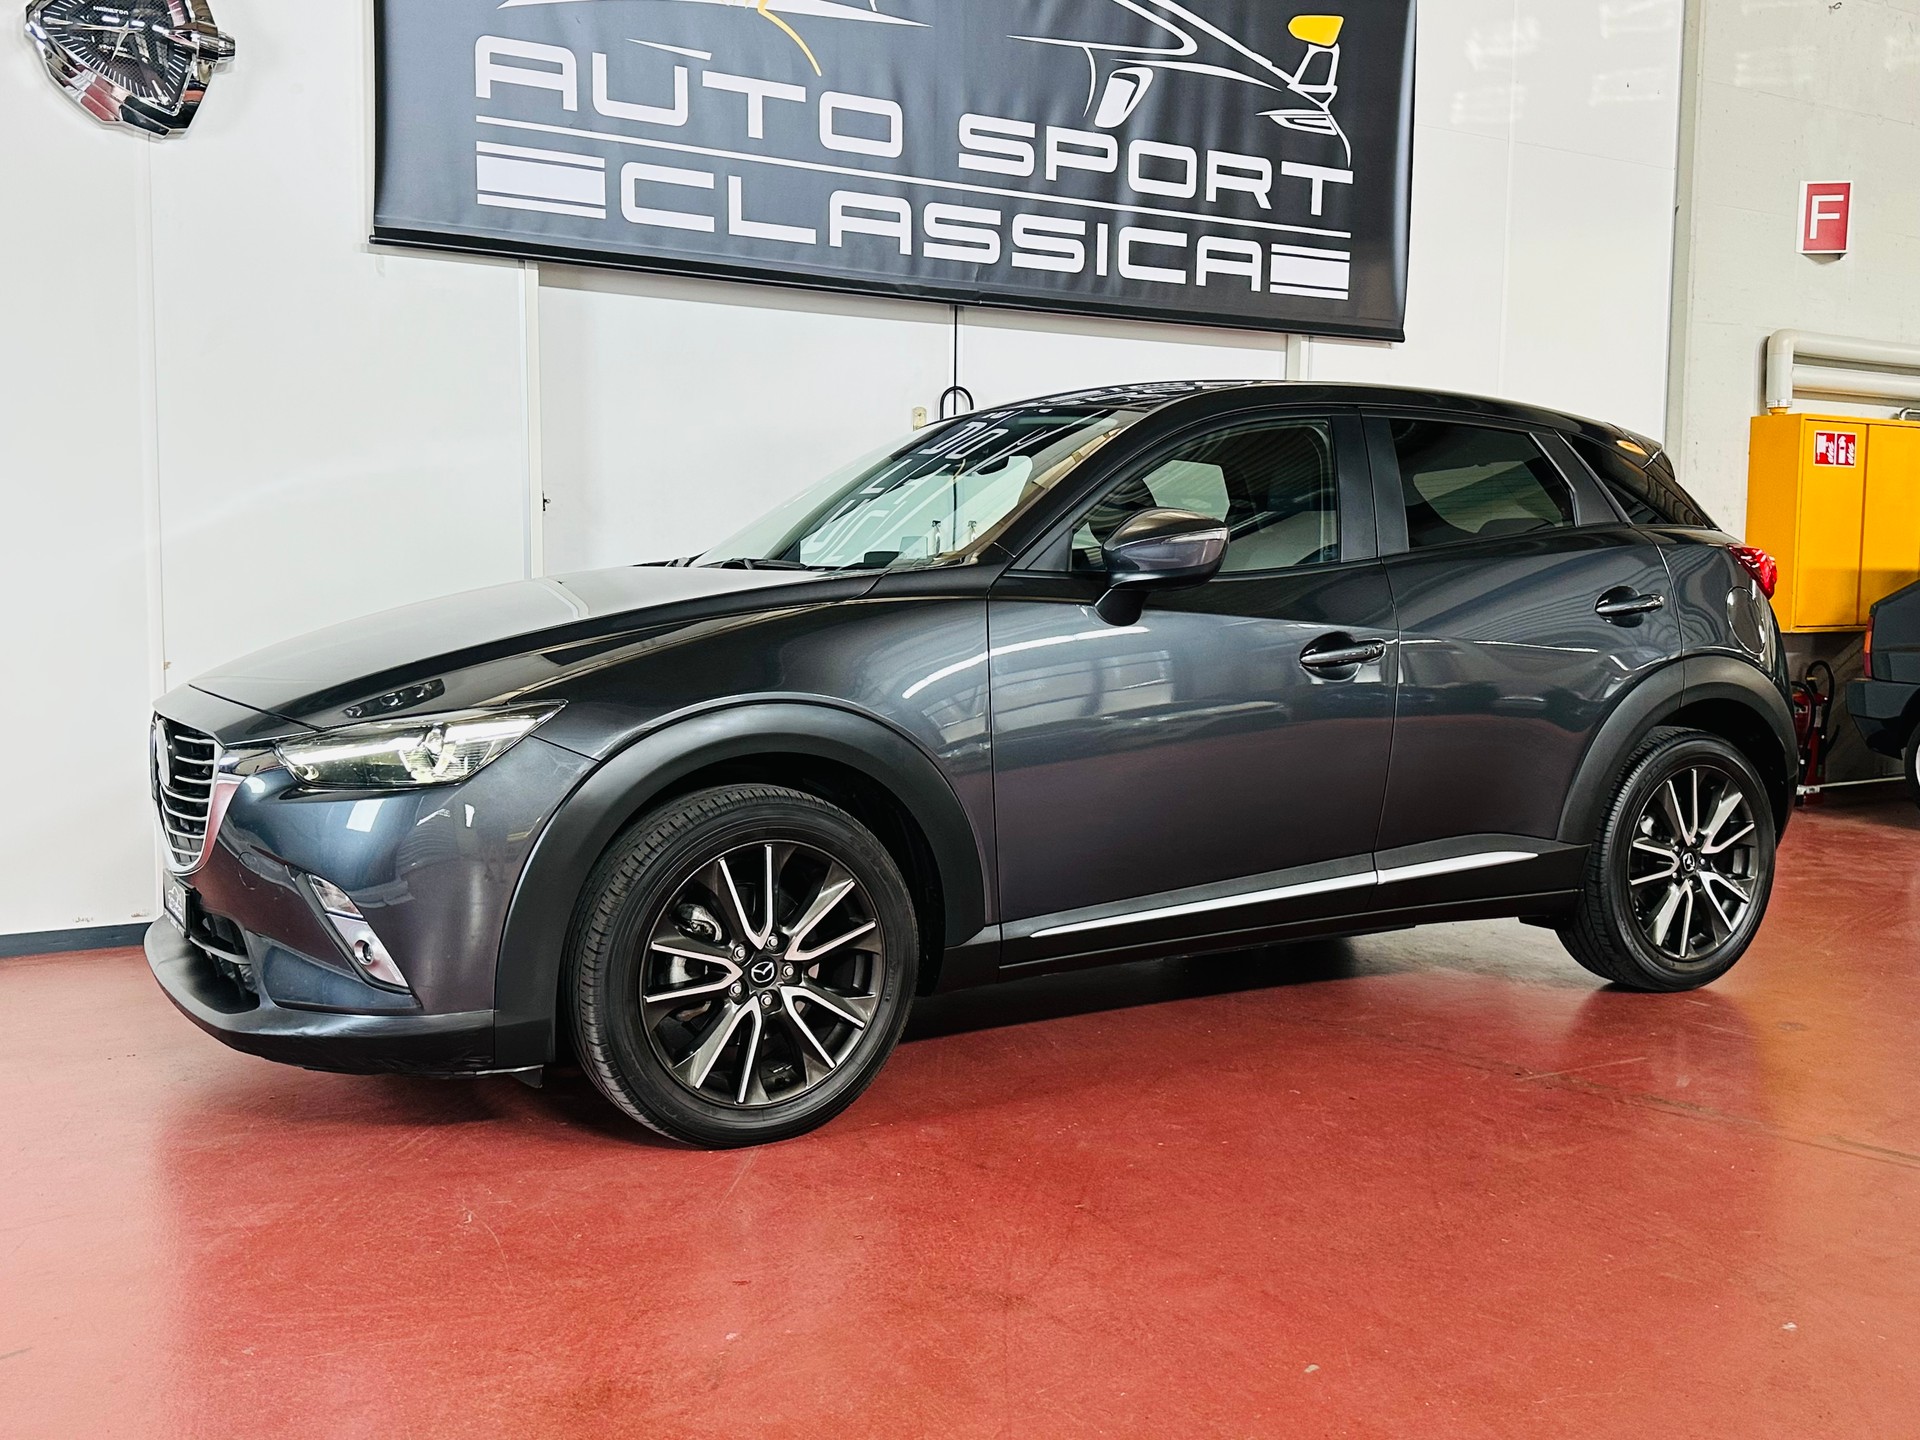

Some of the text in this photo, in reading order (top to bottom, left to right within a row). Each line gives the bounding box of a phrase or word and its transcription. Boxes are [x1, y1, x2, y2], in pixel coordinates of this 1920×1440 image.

[475, 35, 1353, 216] AUTO SPORT
[621, 162, 1262, 292] CLASSICA
[1809, 194, 1844, 239] F
